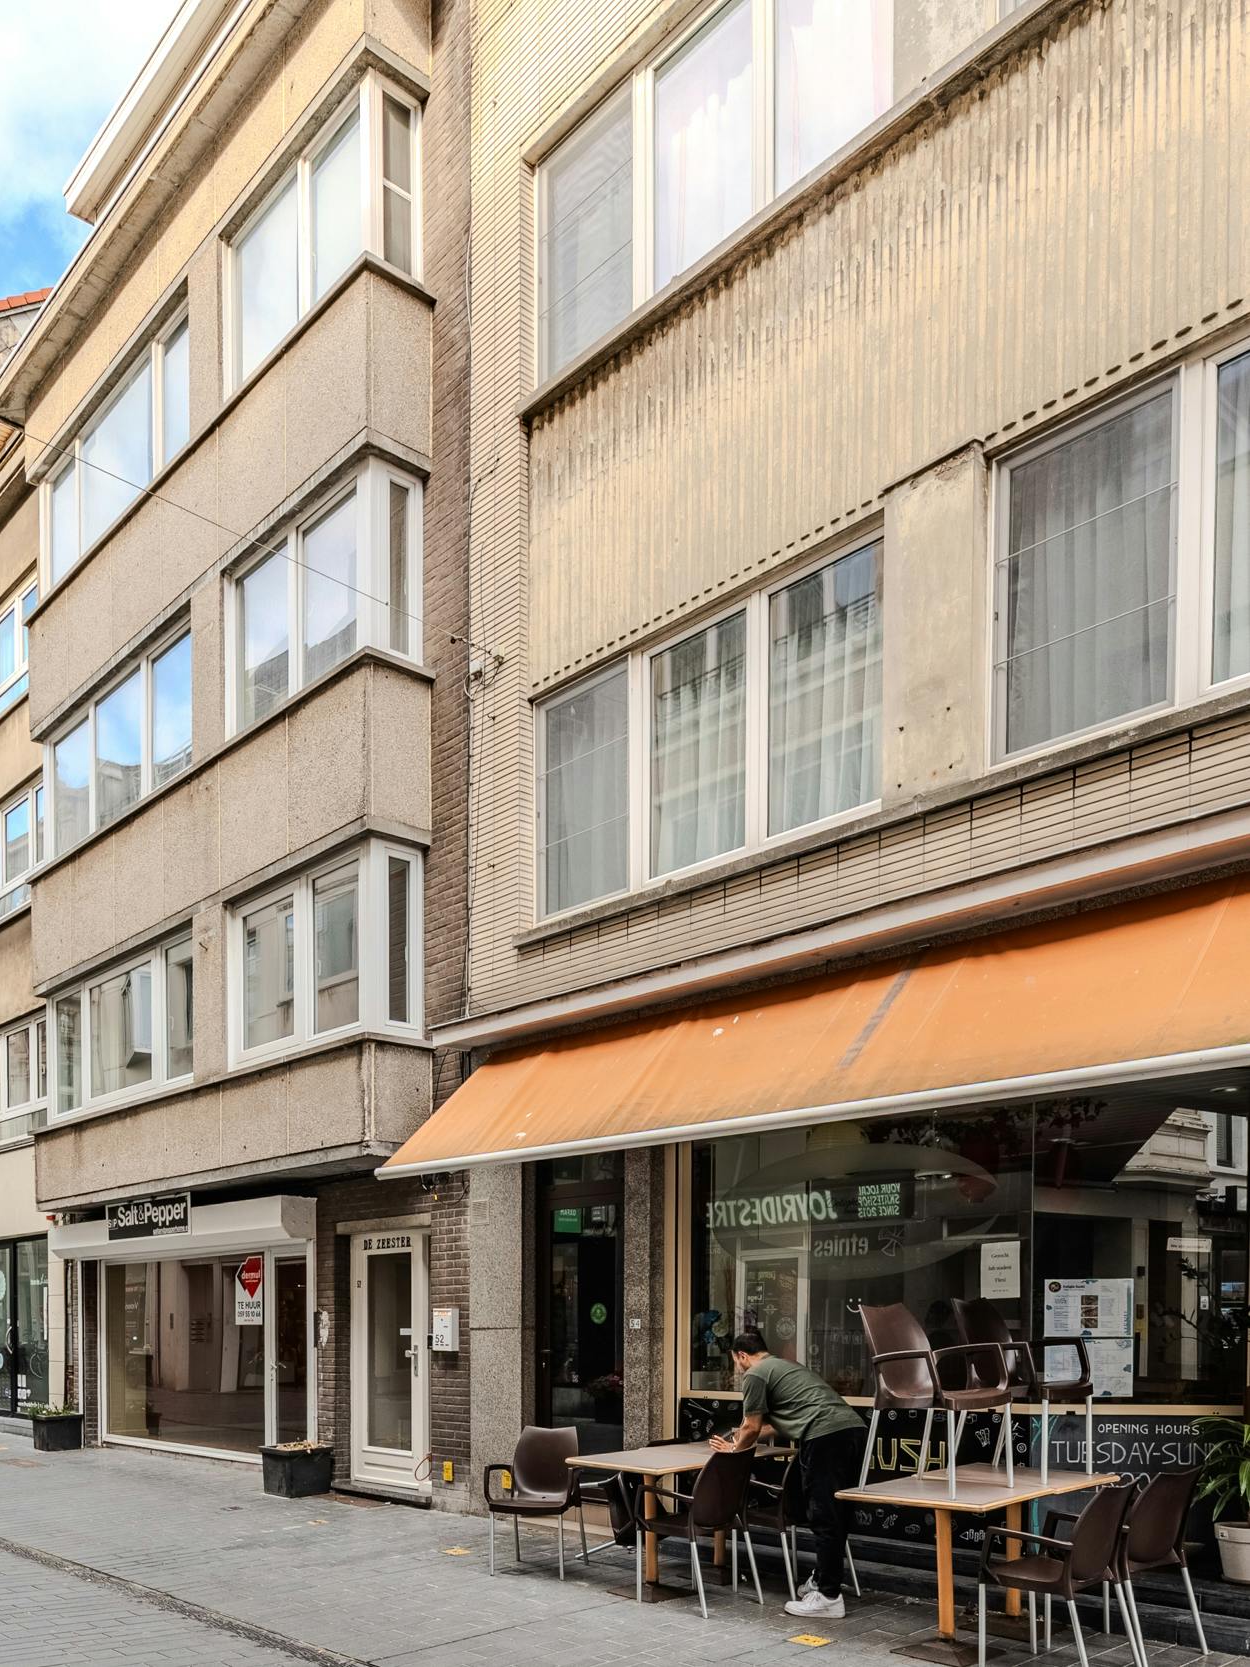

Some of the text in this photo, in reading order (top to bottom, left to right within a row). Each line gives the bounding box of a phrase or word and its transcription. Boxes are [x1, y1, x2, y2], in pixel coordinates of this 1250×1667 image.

[117, 1201, 187, 1228] Salt&Pepper
[363, 1236, 412, 1250] DE ZEESTER
[237, 1301, 262, 1309] TE HUUR
[630, 1319, 641, 1328] 54
[435, 1334, 445, 1344] 52
[1097, 1423, 1150, 1435] OPENING
[869, 1437, 946, 1472] USH
